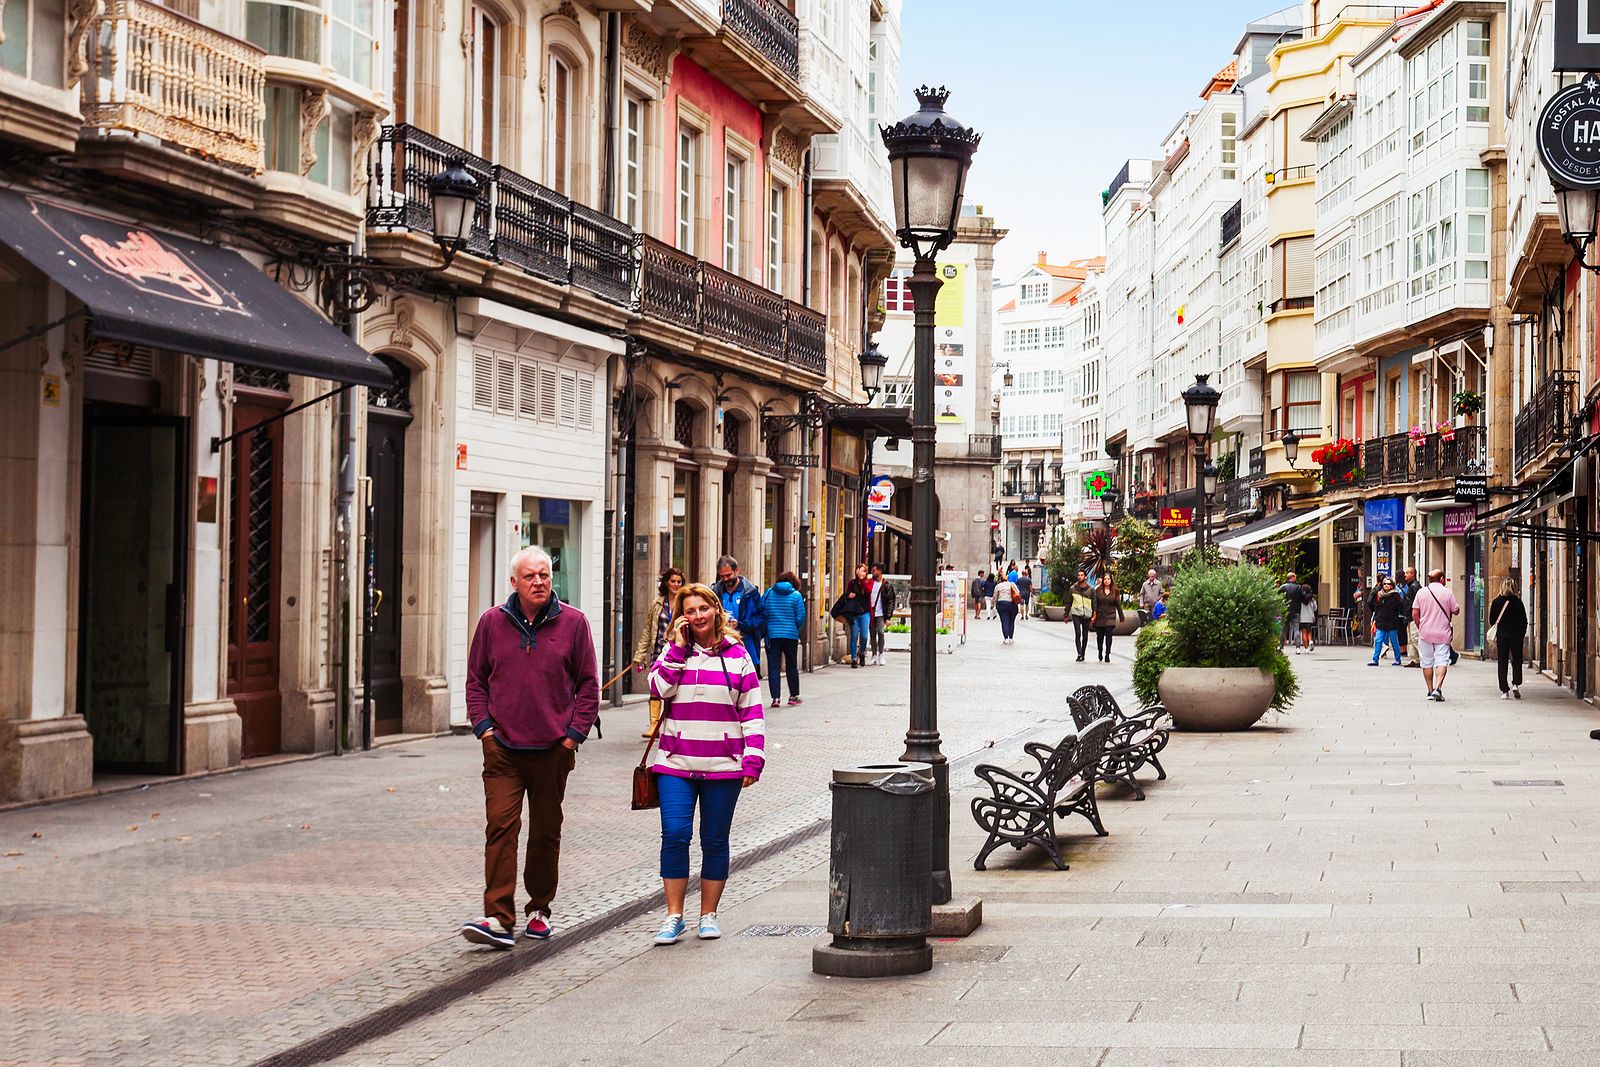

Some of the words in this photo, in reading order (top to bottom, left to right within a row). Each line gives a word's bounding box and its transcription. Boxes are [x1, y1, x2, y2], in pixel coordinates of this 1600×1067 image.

[1550, 97, 1585, 130] HOSTAL
[1562, 158, 1591, 175] DESDE
[1455, 487, 1486, 496] ANABEL
